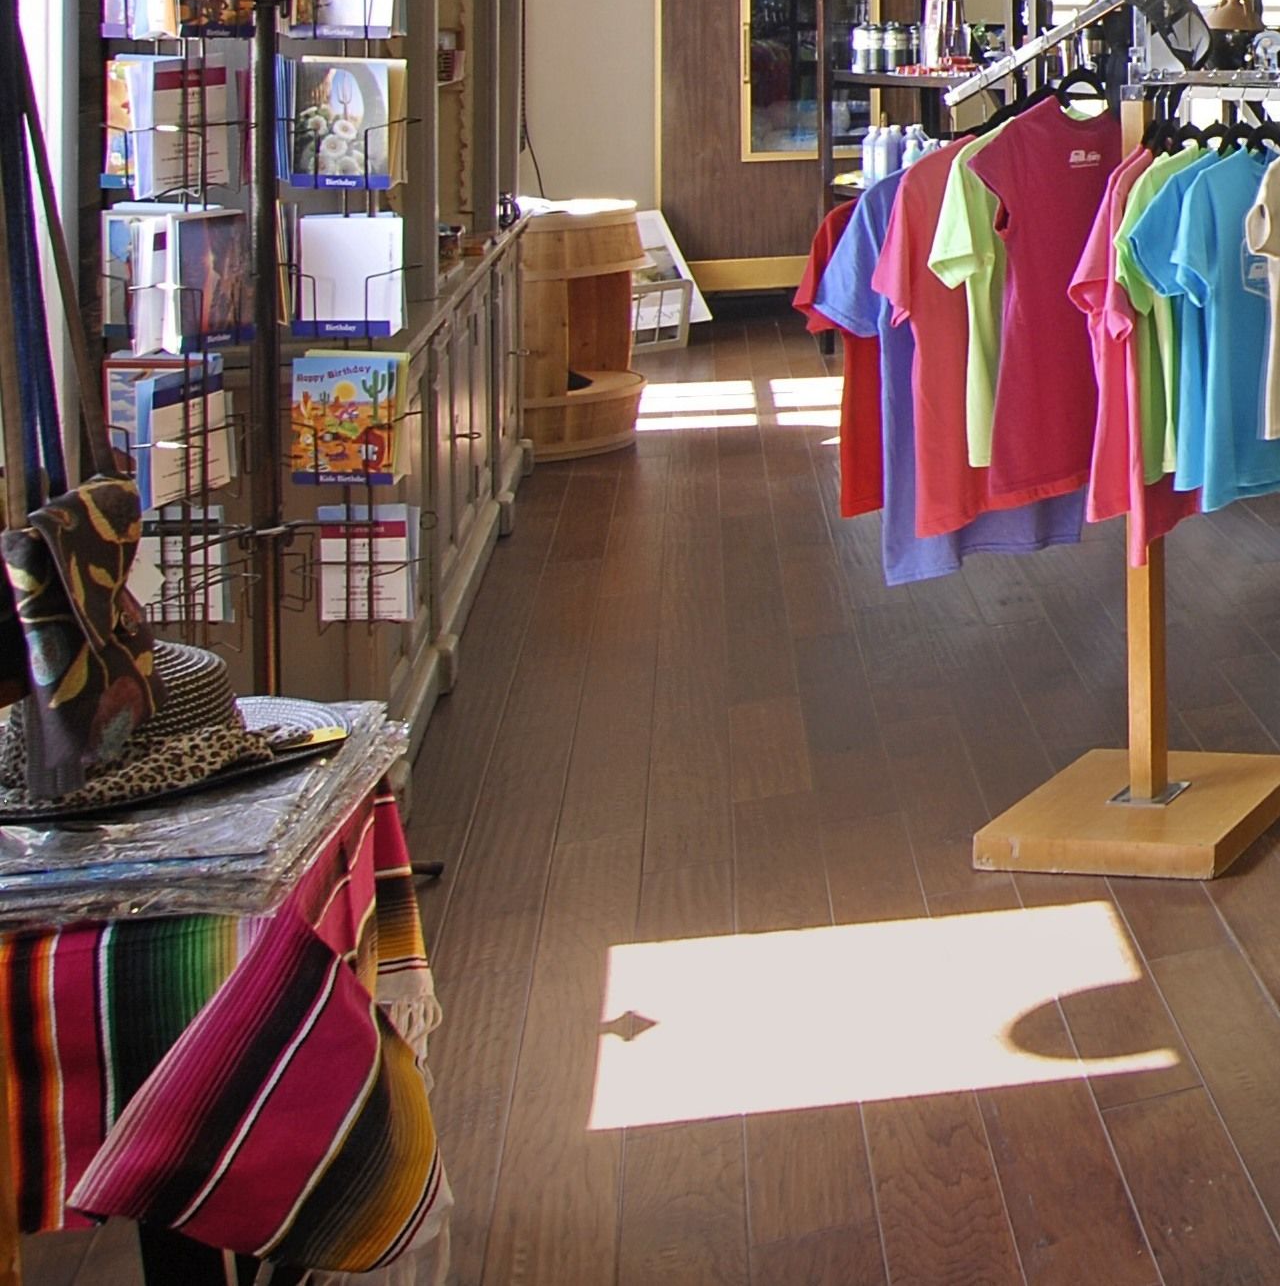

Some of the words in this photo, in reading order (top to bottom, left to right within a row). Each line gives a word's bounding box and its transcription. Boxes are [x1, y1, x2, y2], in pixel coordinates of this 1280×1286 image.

[323, 27, 355, 37] Birthday
[325, 177, 356, 187] Birthday
[325, 323, 357, 332] Birthday
[297, 373, 325, 383] Happy
[327, 365, 372, 379] Birthday
